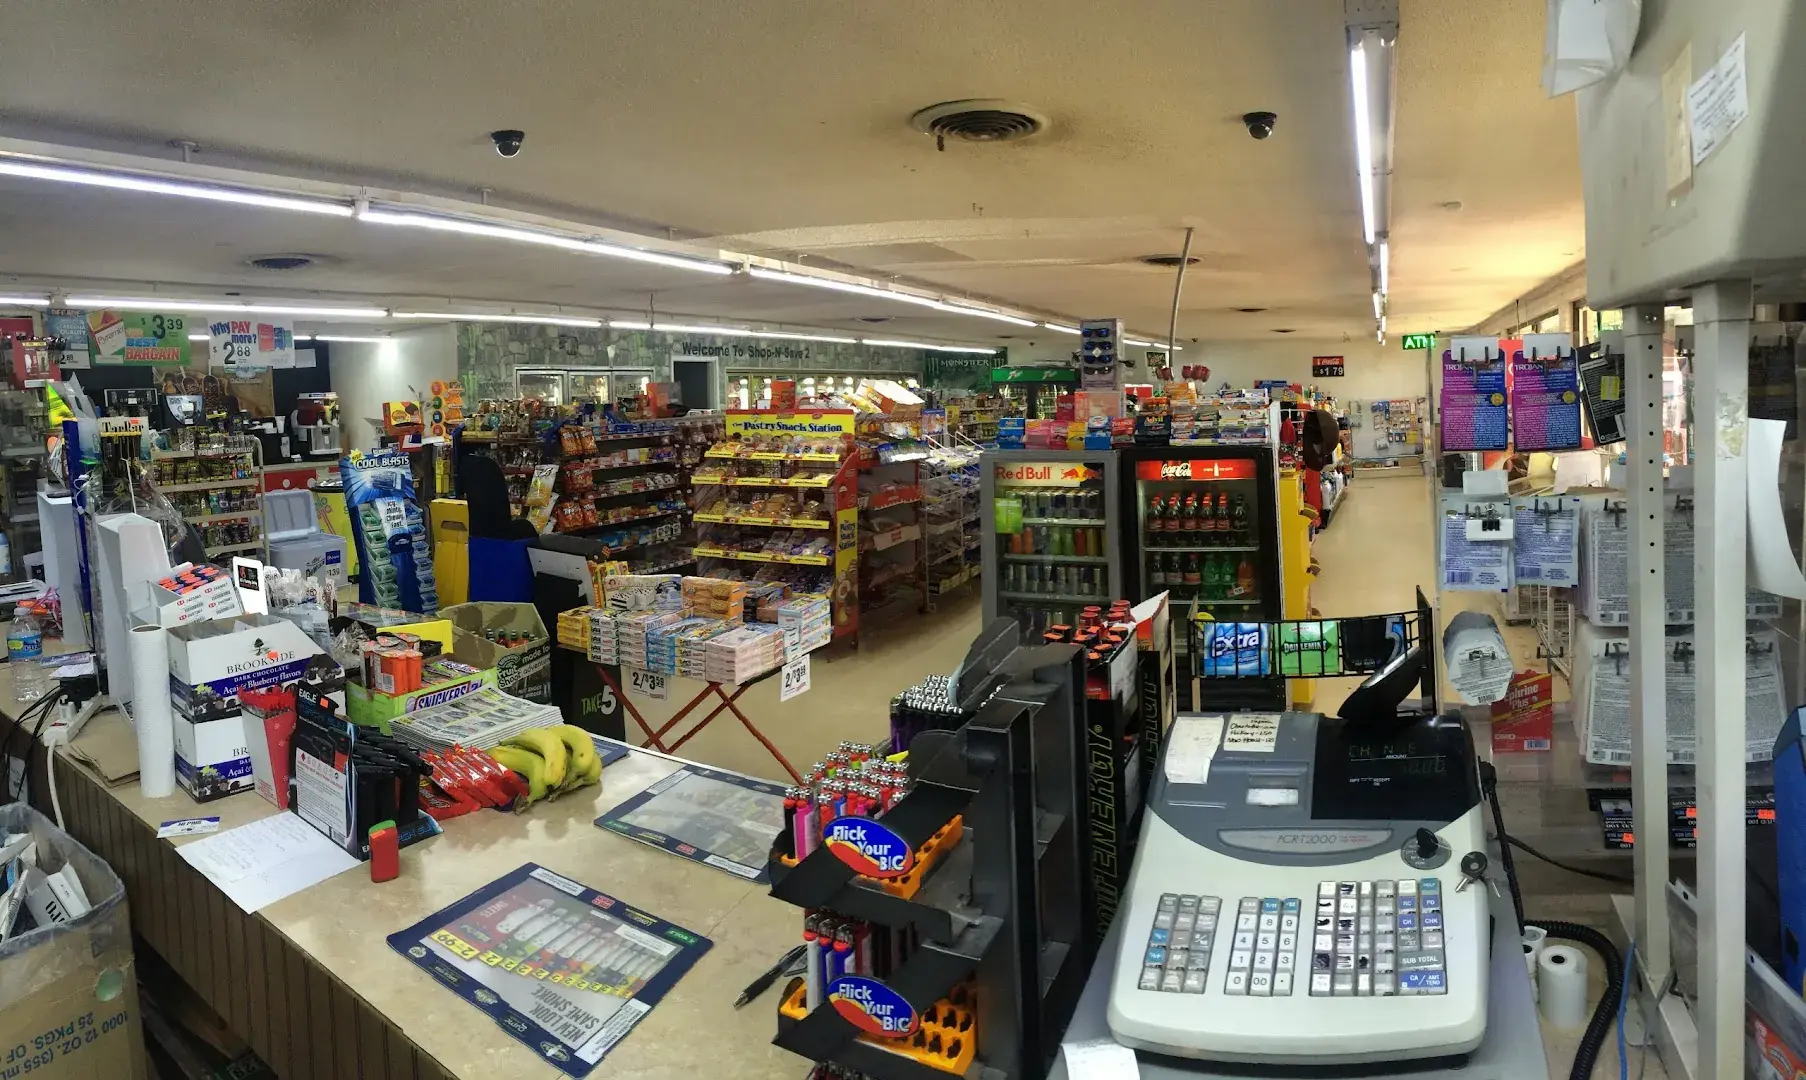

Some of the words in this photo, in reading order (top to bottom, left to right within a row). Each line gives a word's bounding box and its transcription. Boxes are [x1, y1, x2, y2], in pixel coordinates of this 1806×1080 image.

[152, 314, 166, 339] 3
[167, 318, 183, 330] 39
[210, 322, 230, 337] Why
[231, 321, 251, 333] PAY
[126, 338, 157, 347] BEST
[231, 334, 257, 344] more?
[1404, 336, 1435, 348] ATM
[125, 347, 179, 360] BARGAIN
[223, 342, 236, 365] 2
[237, 346, 251, 356] 88
[682, 342, 729, 357] Welcome
[733, 345, 744, 357] To
[805, 349, 810, 359] 2
[941, 359, 989, 367] MONSTER
[743, 421, 776, 433] Pastry
[777, 422, 807, 432] Snack
[808, 423, 843, 433] Station
[356, 459, 380, 470] COOL
[382, 455, 409, 468] BLASTS
[995, 467, 1024, 480] Red
[1026, 466, 1051, 480] Bull
[1212, 631, 1259, 657] Extra
[1385, 616, 1406, 662] 5
[227, 651, 295, 675] BROOKSIDE
[234, 674, 251, 683] DARK
[252, 664, 290, 679] CHOCOLATE
[247, 677, 279, 690] Blueberry
[279, 670, 302, 685] flavors
[497, 665, 517, 679] Fruit
[418, 686, 467, 712] SNICKERS
[581, 693, 602, 715] TAKE
[600, 685, 616, 715] 5
[1511, 698, 1529, 710] Plus
[1088, 727, 1118, 877] ENERGY
[832, 825, 866, 842] Flick
[857, 841, 891, 856] Your
[879, 855, 904, 871] BIC
[1286, 919, 1293, 927] 9
[437, 933, 456, 947] 99
[1259, 956, 1266, 964] 2
[1282, 956, 1289, 964] 3
[1233, 976, 1241, 984] 0
[1253, 977, 1267, 985] 00
[532, 983, 567, 1011] SMOKE.
[839, 983, 872, 1000] Flick
[532, 1002, 567, 1029] LOOK.
[862, 1000, 894, 1016] Your
[77, 1012, 94, 1029] 25
[101, 1010, 128, 1034] 1000
[566, 1005, 600, 1031] SAME
[882, 1016, 910, 1032] BIC
[30, 1022, 74, 1050] PKGS.
[85, 1028, 99, 1043] 12
[565, 1022, 586, 1043] NEW
[6, 1045, 27, 1064] OF
[57, 1036, 82, 1056] OZ.
[24, 1048, 54, 1074] (355
